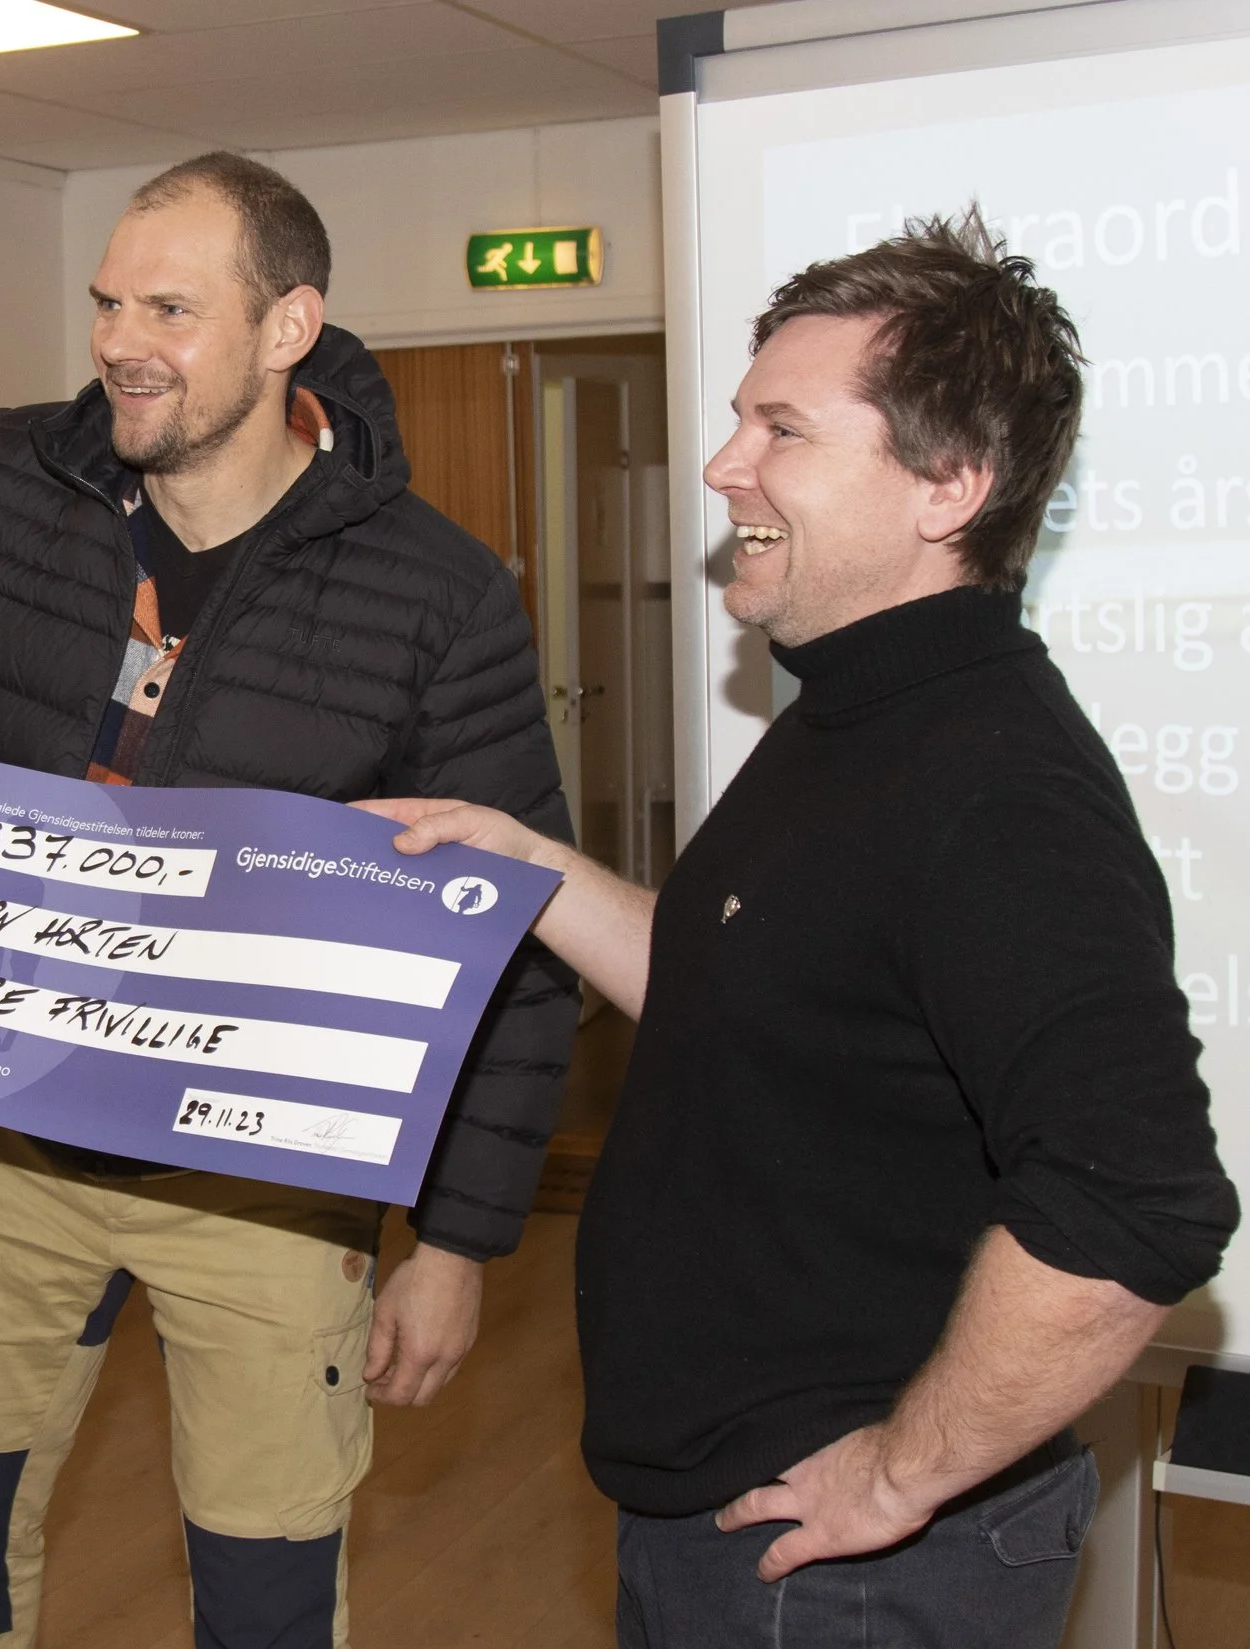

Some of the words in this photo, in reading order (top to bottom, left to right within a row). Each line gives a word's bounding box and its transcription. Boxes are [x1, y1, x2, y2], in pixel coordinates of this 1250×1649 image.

[28, 809, 133, 836] Gjensidigestiftelsen
[136, 826, 170, 838] tildeler
[171, 828, 205, 840] kroner:
[236, 846, 436, 894] GjensidigeStiftelsen
[34, 916, 178, 961] HORTEN
[48, 996, 240, 1054] FRIVILLIGE
[179, 1099, 265, 1136] 29.11.23
